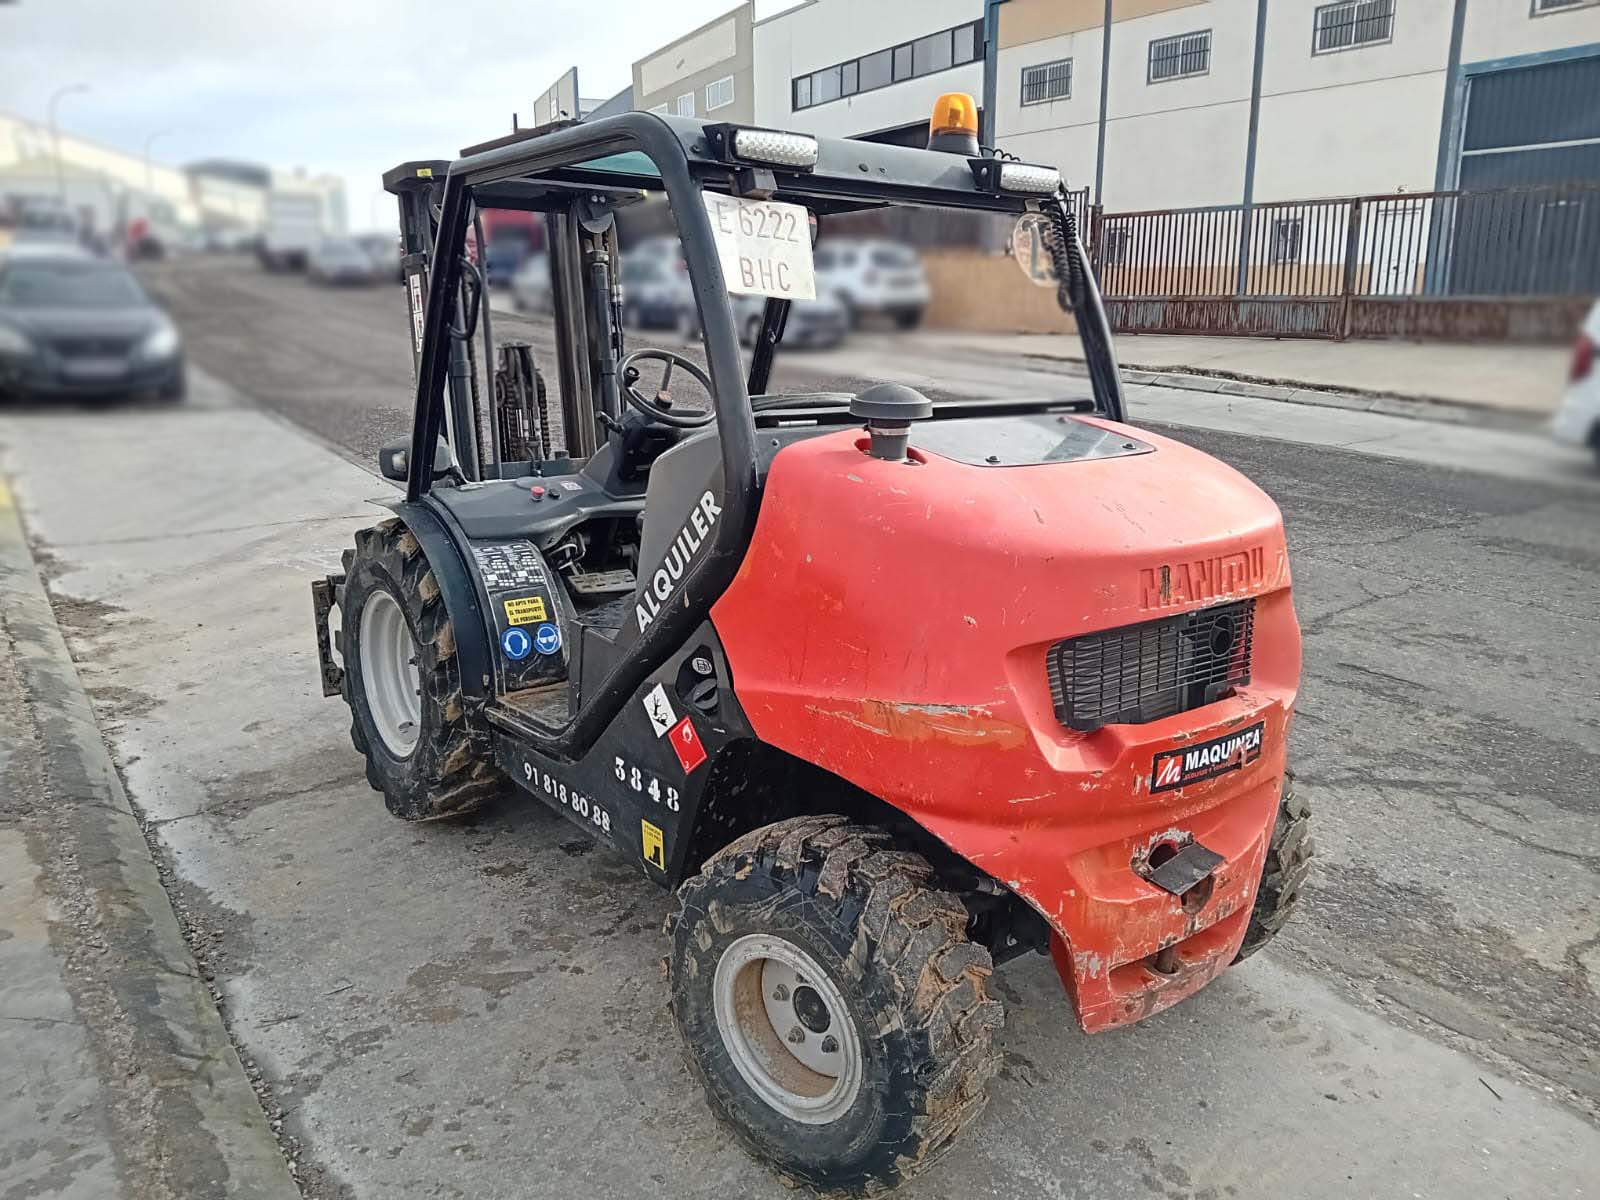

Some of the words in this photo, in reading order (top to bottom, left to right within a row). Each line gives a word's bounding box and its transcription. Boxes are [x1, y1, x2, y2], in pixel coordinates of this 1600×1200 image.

[717, 202, 732, 233] E
[739, 206, 799, 242] 6222
[740, 256, 790, 291] BHC
[635, 490, 722, 634] ALQUILER
[524, 762, 538, 786] 91
[543, 774, 568, 804] 818
[571, 791, 589, 817] 80
[592, 805, 610, 832] 88
